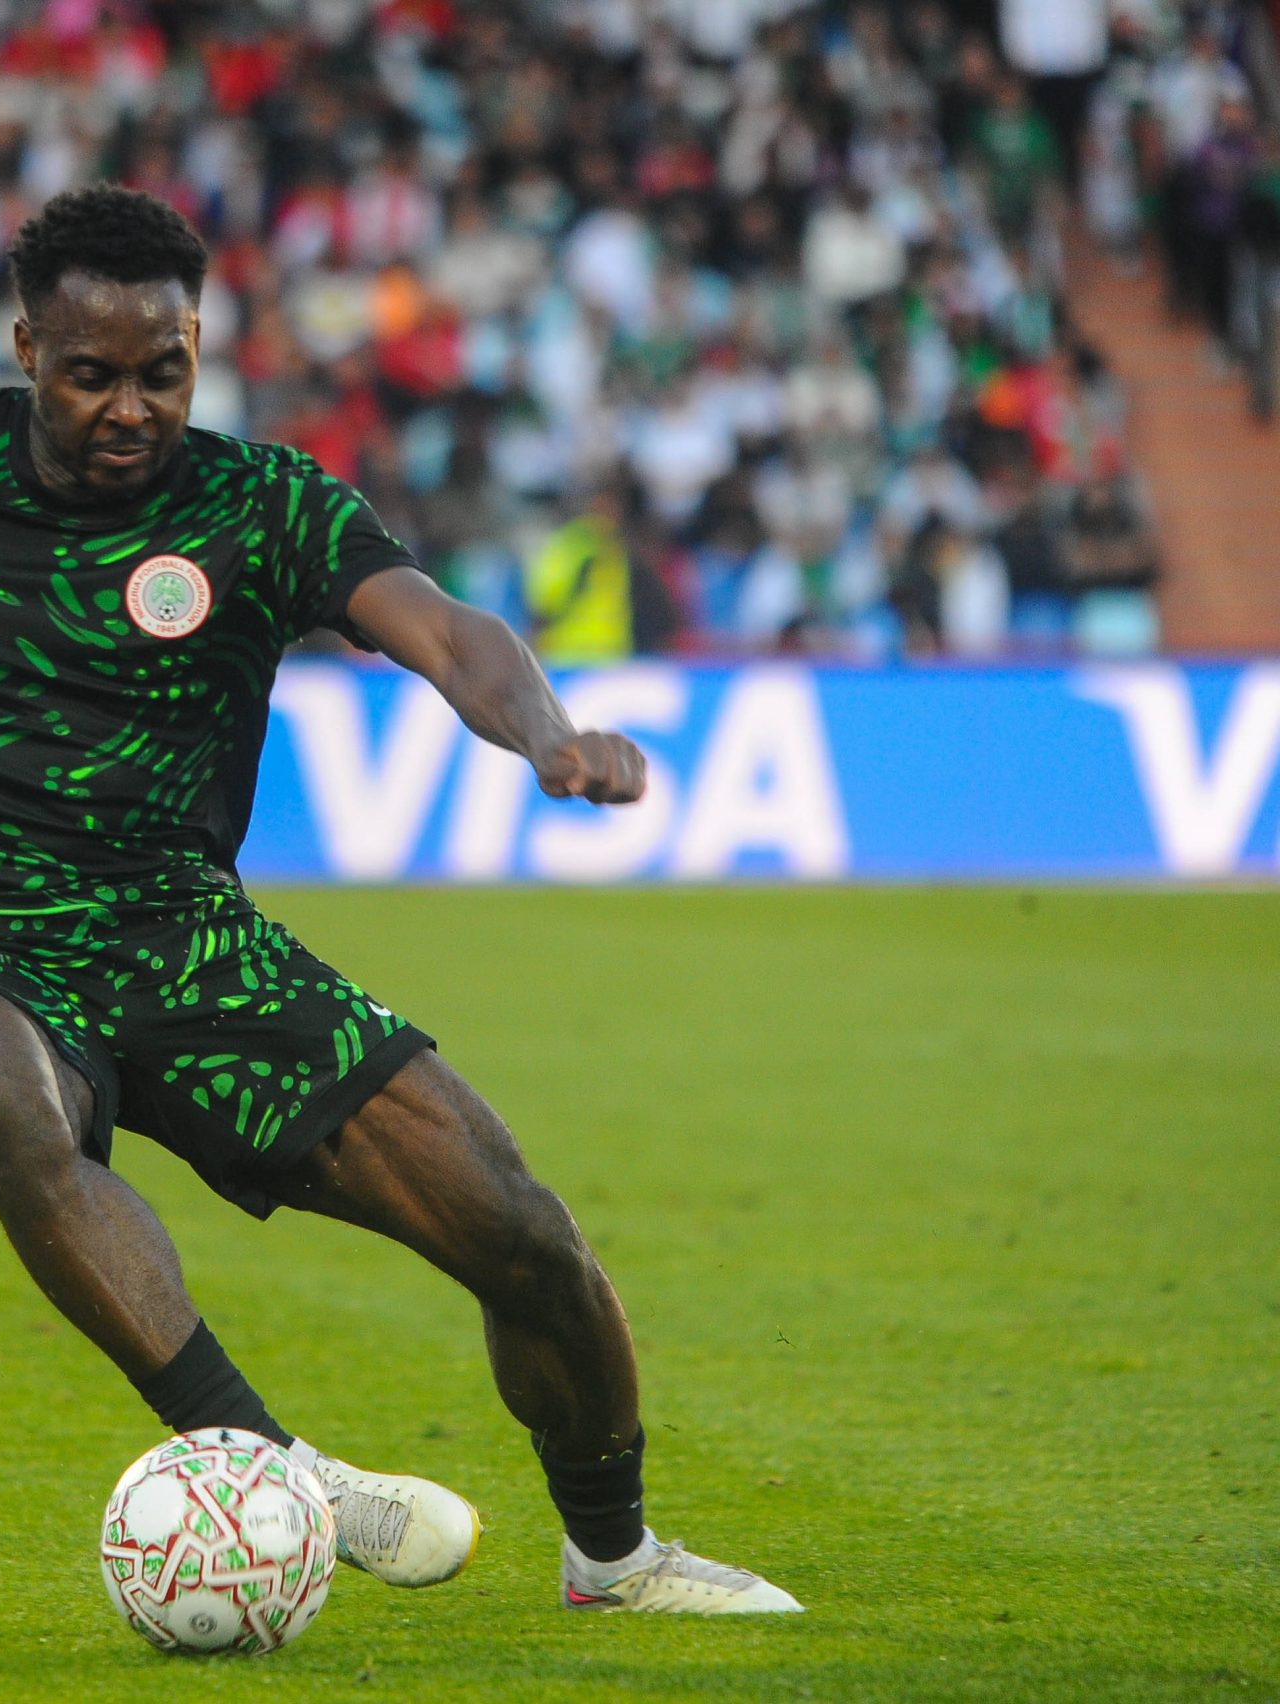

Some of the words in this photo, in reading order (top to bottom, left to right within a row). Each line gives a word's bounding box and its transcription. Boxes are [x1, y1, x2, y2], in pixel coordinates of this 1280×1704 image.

[130, 581, 145, 620] NIGERIA
[138, 560, 185, 580] FOOTBALL
[186, 567, 206, 625] FEDERATION
[155, 624, 177, 633] 1945
[270, 661, 852, 881] VISA
